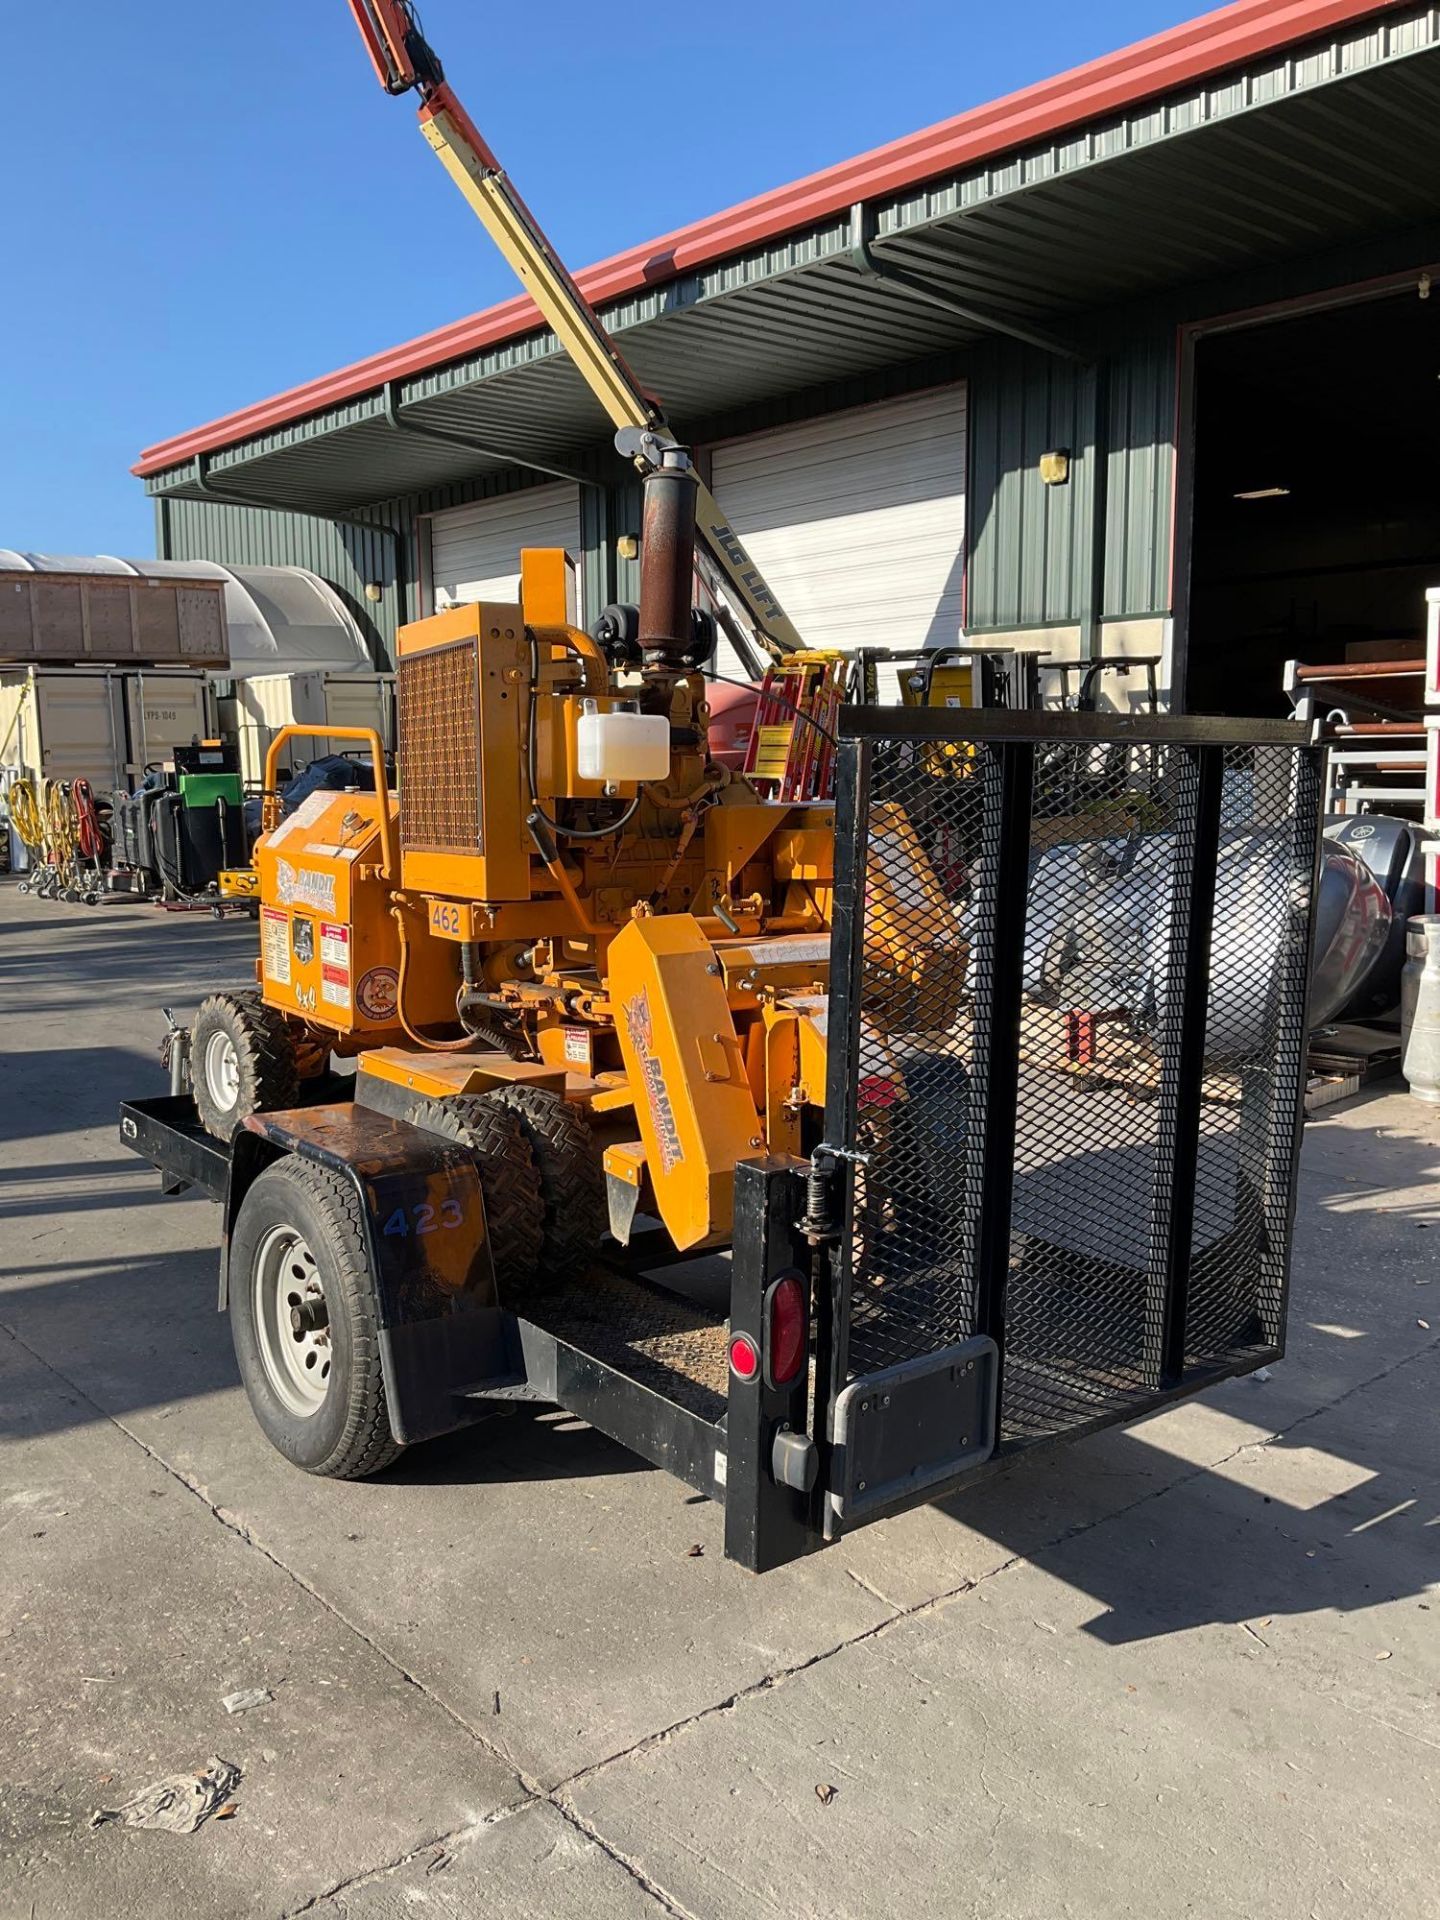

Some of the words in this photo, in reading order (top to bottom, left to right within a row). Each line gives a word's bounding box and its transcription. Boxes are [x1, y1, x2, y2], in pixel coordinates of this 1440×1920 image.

[710, 525, 748, 566] JLG
[740, 570, 783, 619] LIFT
[298, 869, 335, 893] BANDIT
[433, 905, 460, 934] 462
[295, 981, 317, 1012] 4x4
[649, 1058, 684, 1160] BANDIT
[383, 1200, 464, 1237] 423
